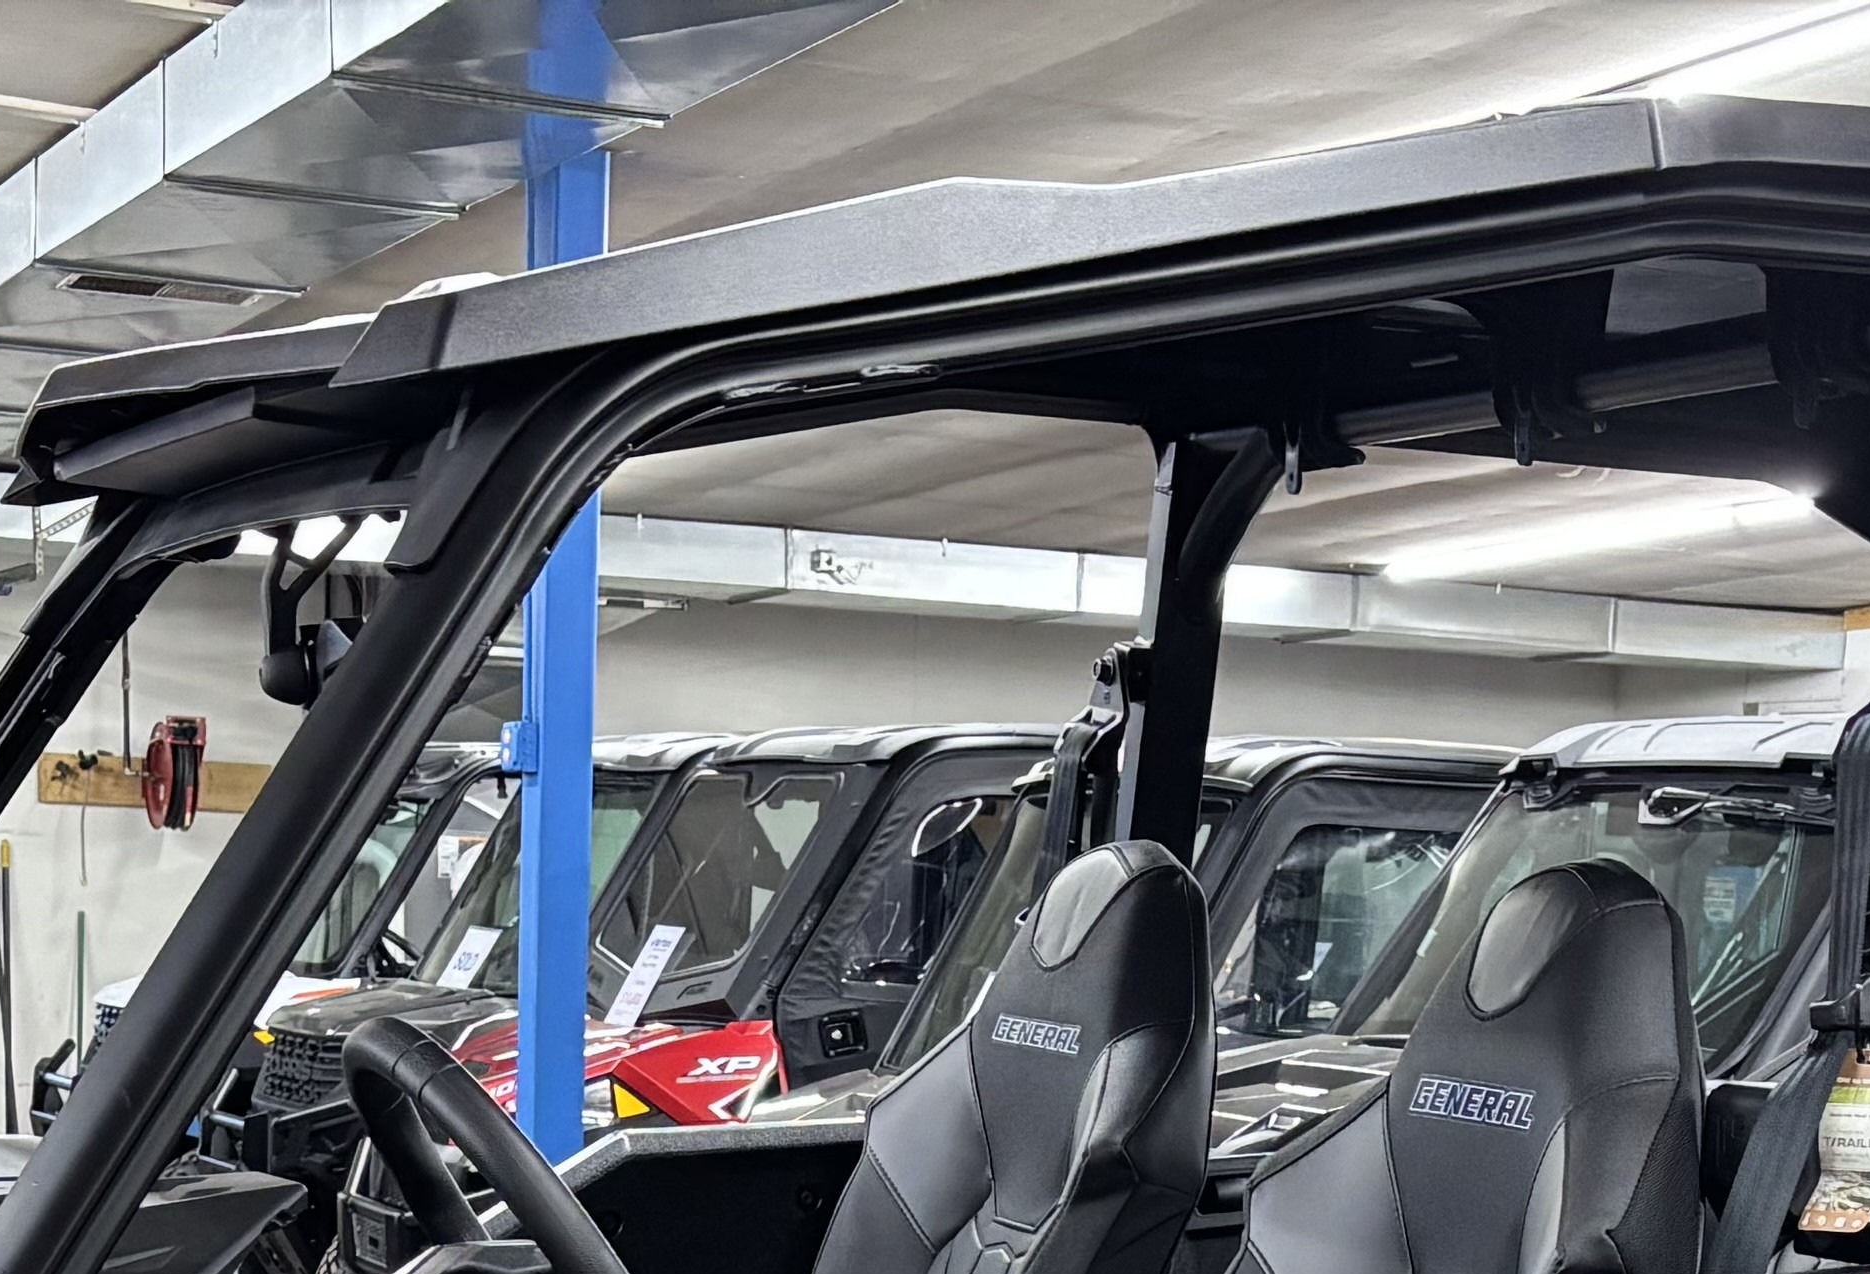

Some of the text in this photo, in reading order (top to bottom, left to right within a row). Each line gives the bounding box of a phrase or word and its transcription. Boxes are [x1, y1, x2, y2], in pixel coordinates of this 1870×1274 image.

[992, 1014, 1082, 1055] GENERAL
[687, 1055, 761, 1076] XP
[1409, 1077, 1535, 1130] GENERAL
